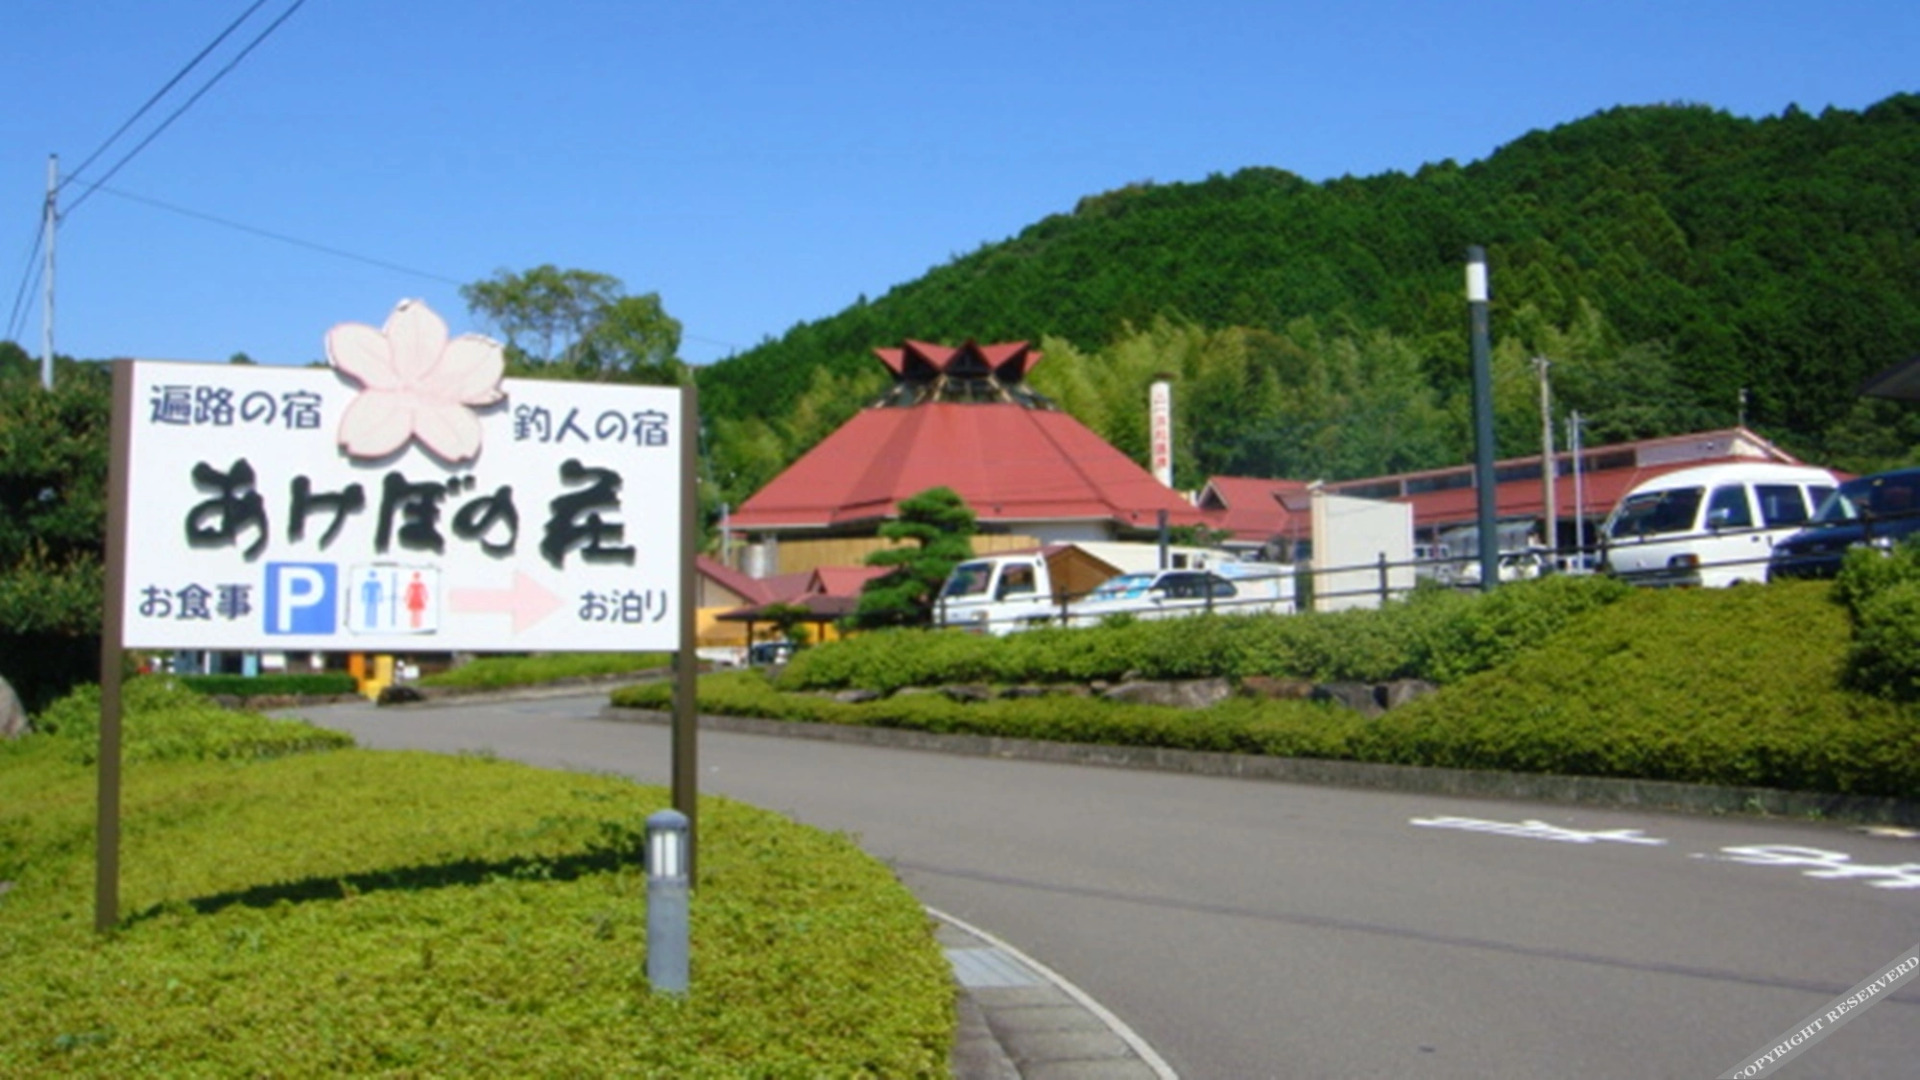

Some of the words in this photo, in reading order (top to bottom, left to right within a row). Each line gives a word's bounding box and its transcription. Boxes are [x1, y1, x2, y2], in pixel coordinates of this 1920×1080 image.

[150, 384, 322, 429] 遍路の宿
[514, 403, 669, 446] 釣人の宿
[139, 583, 252, 621] お食事
[278, 567, 325, 633] P
[578, 589, 668, 623] お泊り
